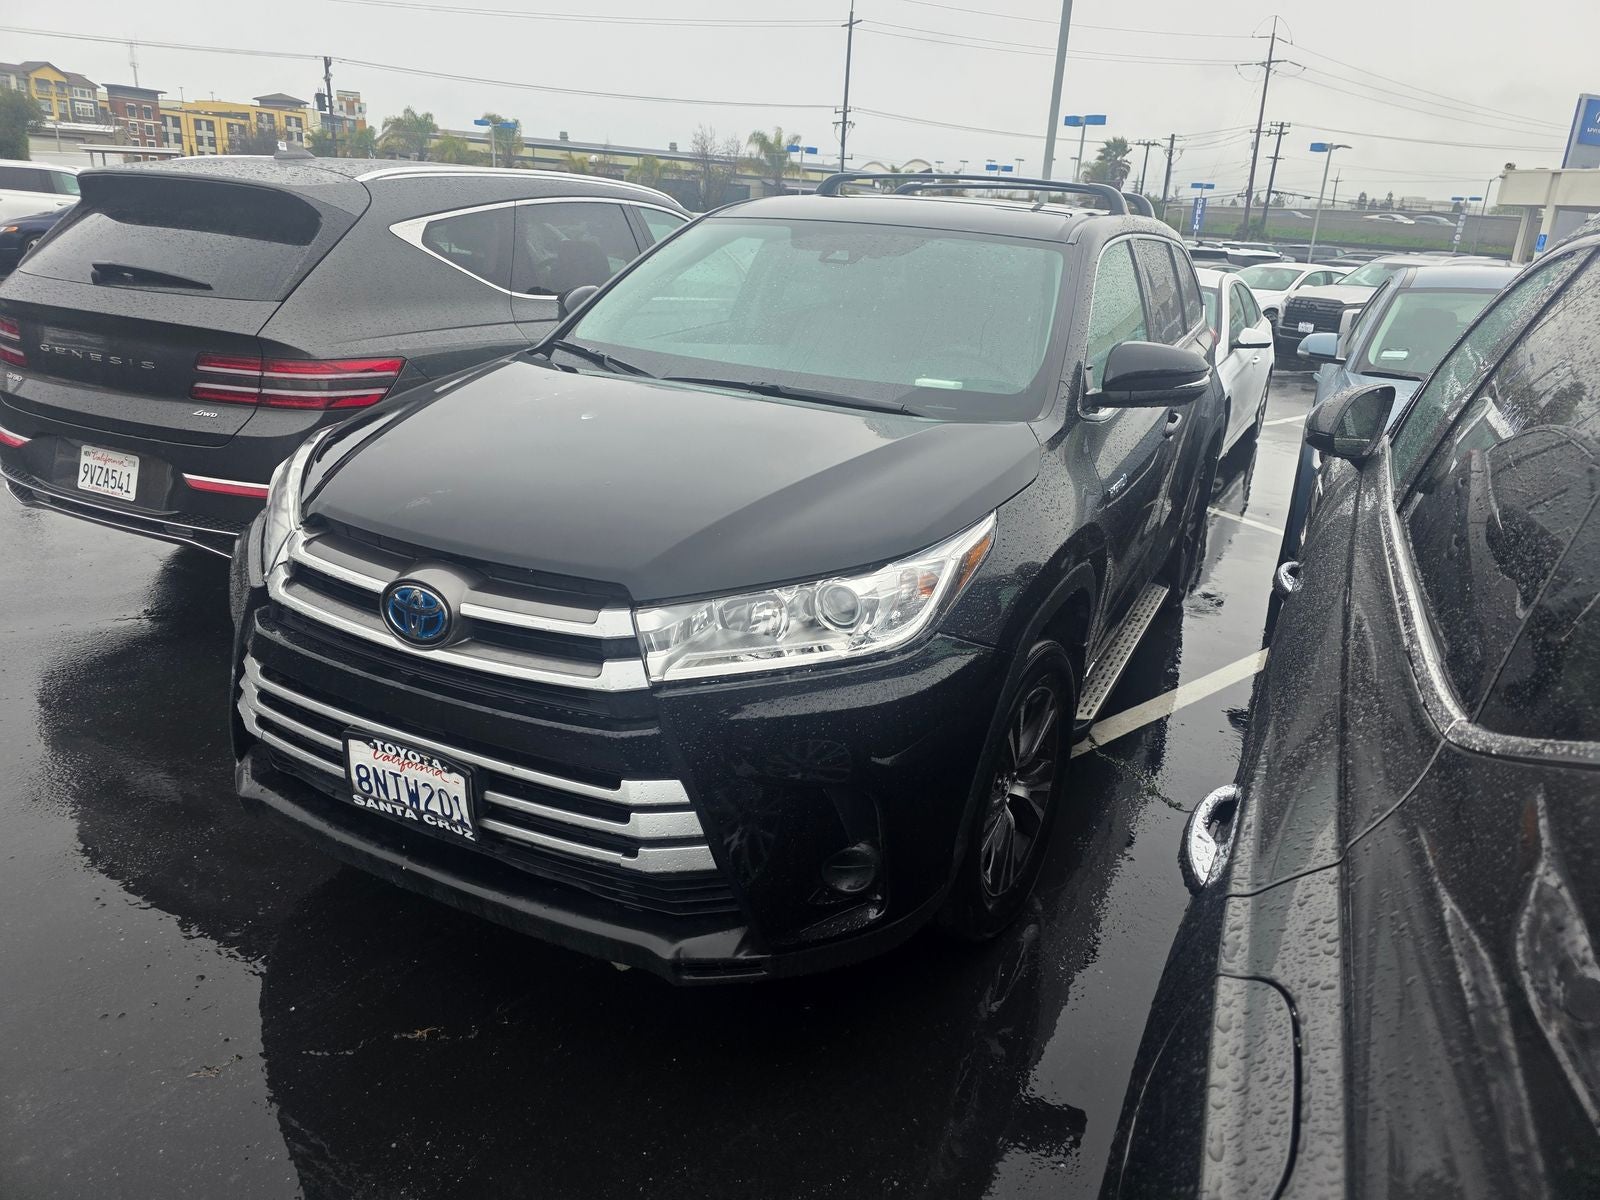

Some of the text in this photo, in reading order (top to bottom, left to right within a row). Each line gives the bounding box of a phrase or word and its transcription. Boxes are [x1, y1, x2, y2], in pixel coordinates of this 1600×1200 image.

[1193, 198, 1204, 230] DUBLIN
[40, 344, 155, 370] GENESIS
[91, 449, 128, 468] California
[81, 462, 131, 494] 9VZA541
[373, 739, 442, 770] TOYOTA
[353, 794, 476, 842] SANTA CRUZ
